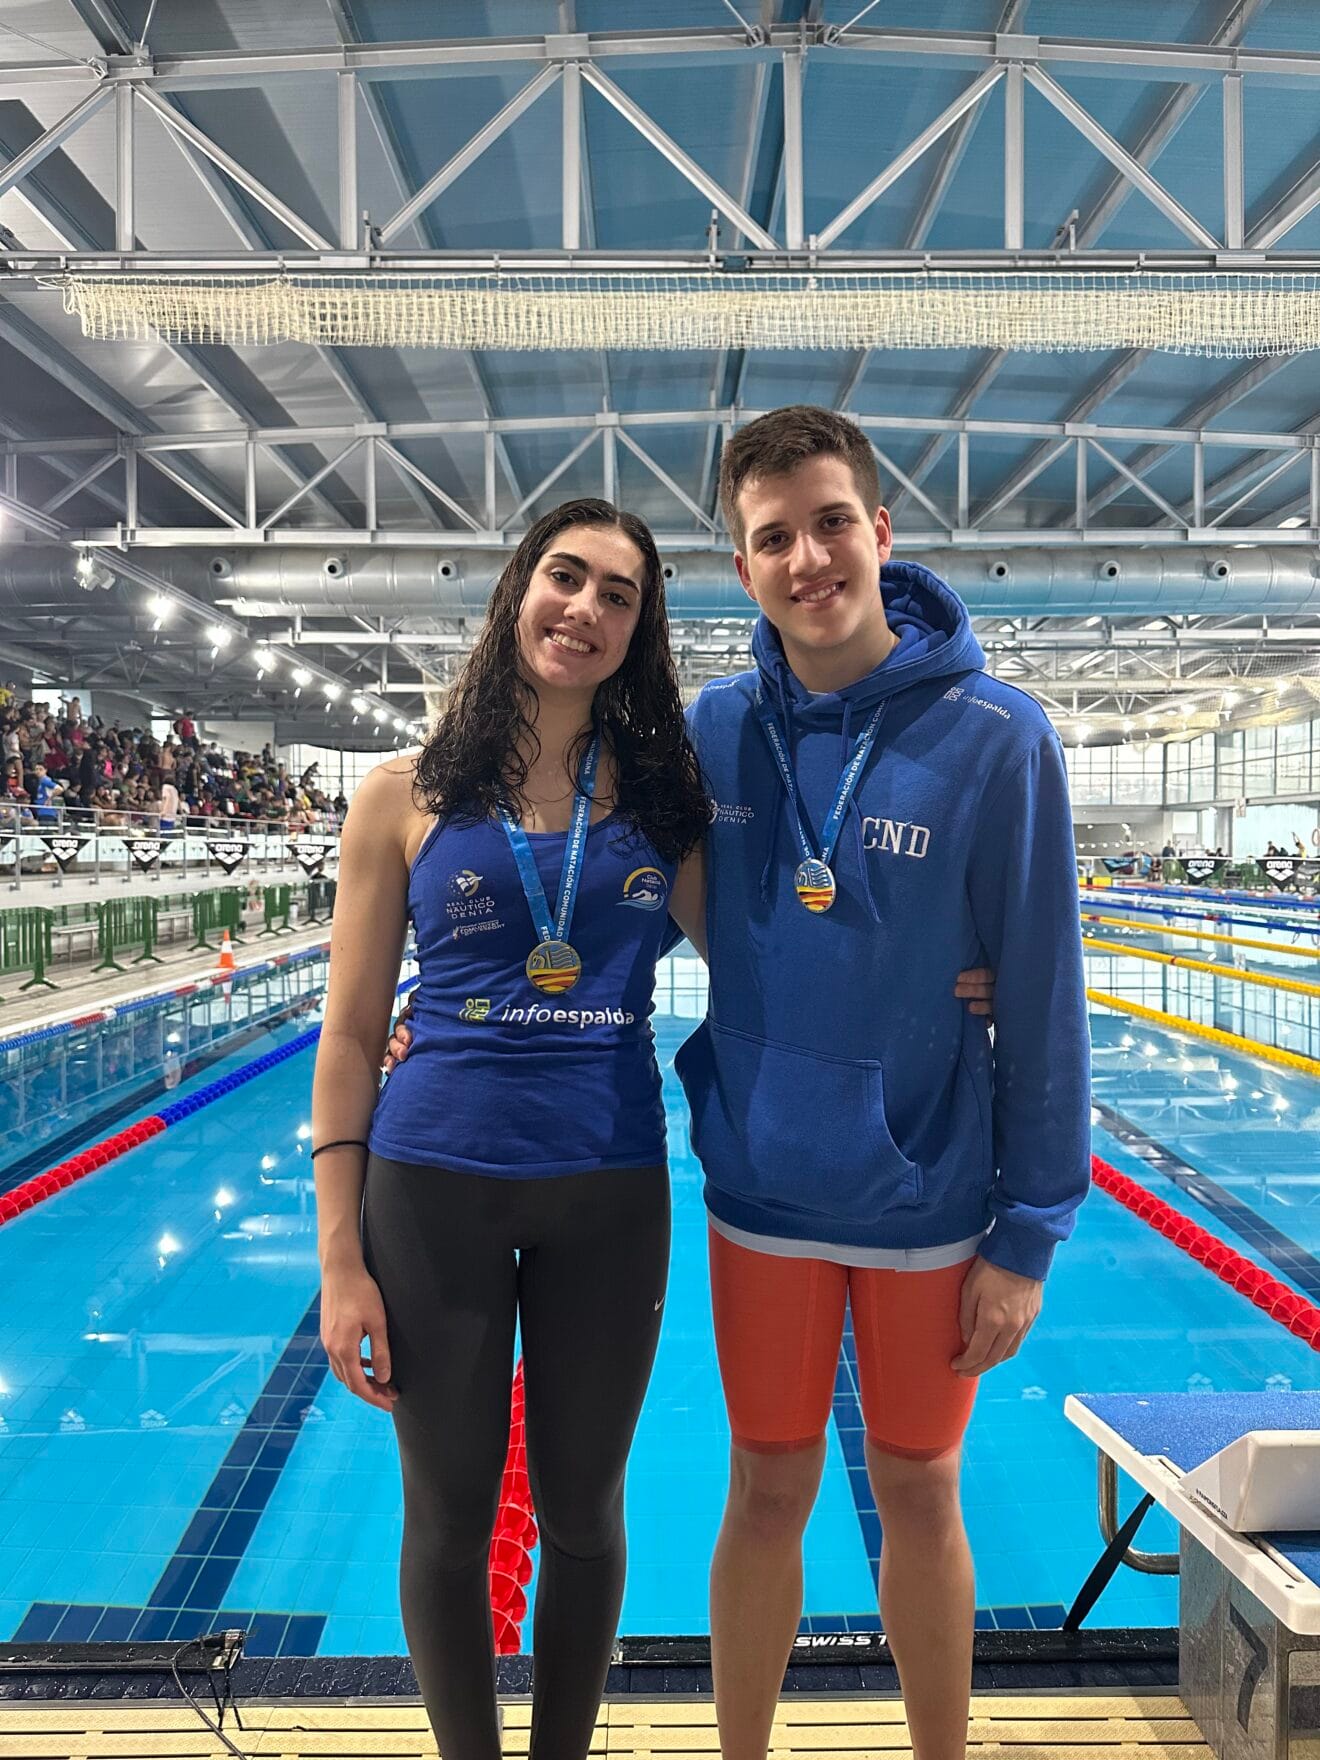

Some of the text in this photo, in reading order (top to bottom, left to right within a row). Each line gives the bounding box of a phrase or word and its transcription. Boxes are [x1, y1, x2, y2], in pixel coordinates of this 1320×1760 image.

[962, 693, 1011, 720] infoespalda
[767, 722, 785, 763] FEDERACIÓN
[781, 763, 790, 773] DE
[856, 725, 875, 759] NATACIÓN
[852, 760, 861, 771] DE
[833, 774, 853, 820] FEDERACIÓN
[52, 839, 78, 848] arena
[862, 816, 931, 858] CND
[134, 841, 160, 850] arena
[215, 843, 243, 852] arena
[556, 796, 587, 937] FEDERACIÓN DE NATACIÓN COMUNIDAD
[1187, 860, 1215, 868] arena
[1266, 860, 1293, 869] arena
[451, 907, 493, 919] DENIA
[501, 1003, 635, 1029] infoespalda
[793, 1635, 871, 1648] SWISS
